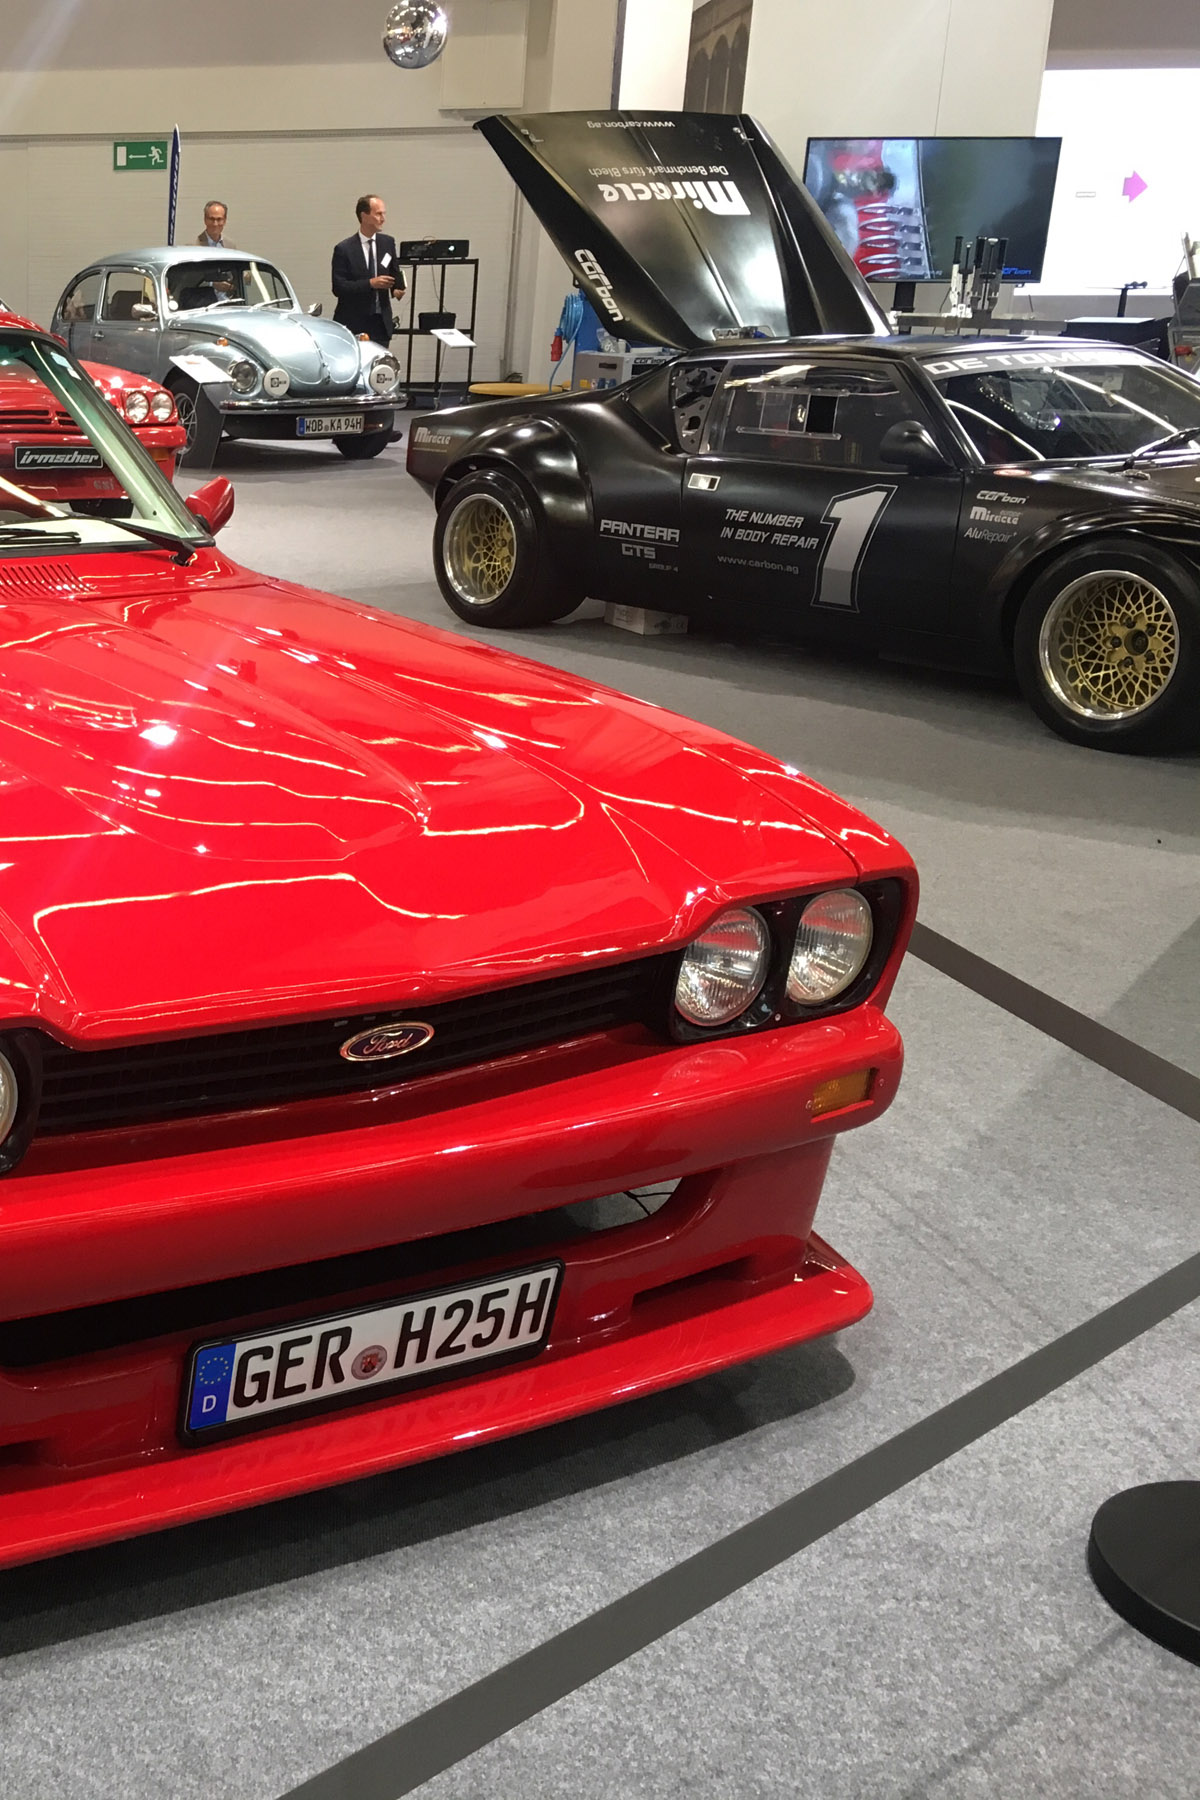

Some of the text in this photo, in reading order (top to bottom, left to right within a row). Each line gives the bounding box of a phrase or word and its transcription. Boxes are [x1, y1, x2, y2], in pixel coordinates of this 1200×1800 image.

[586, 120, 676, 129] www.carbon.ag
[588, 165, 729, 177] Der Benchmark fürs Blech
[598, 180, 752, 216] Miracle
[574, 248, 625, 322] carbon
[923, 357, 988, 375] DE
[305, 418, 362, 432] WOB KA 94H
[414, 427, 451, 444] Miracle
[20, 450, 99, 464] irmscher
[976, 490, 1027, 504] carbon
[725, 508, 804, 528] THE NUMBER
[970, 506, 1019, 525] Miracle
[600, 519, 680, 541] PANTERA
[720, 527, 820, 550] IN BODY REPAIR
[621, 543, 656, 559] GTS
[811, 484, 898, 613] 1
[717, 555, 800, 574] www.carbon.ag
[363, 1031, 414, 1054] Ford
[232, 1277, 551, 1408] GER H25H
[202, 1394, 217, 1413] D
